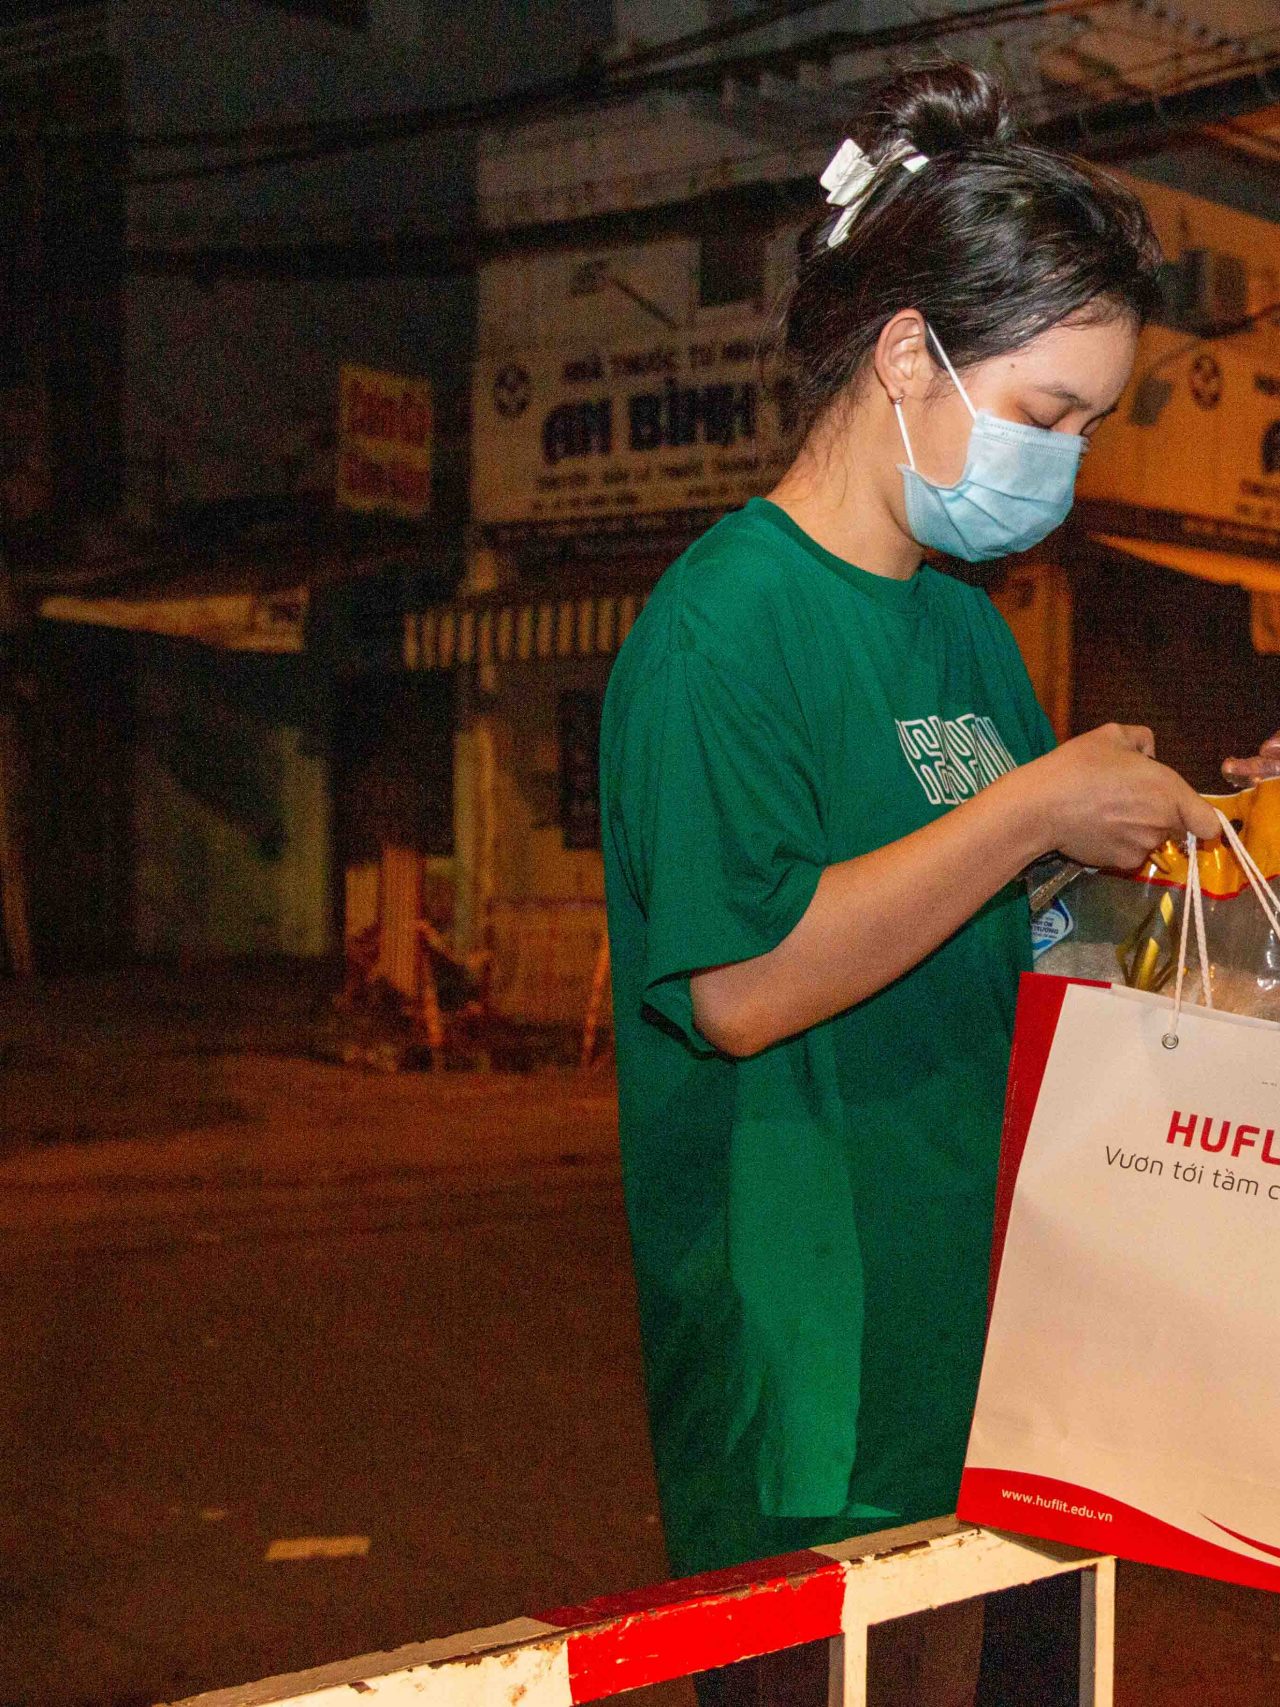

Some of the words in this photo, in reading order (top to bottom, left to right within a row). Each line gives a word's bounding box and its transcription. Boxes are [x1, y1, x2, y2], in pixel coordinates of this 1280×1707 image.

[542, 398, 613, 466] AN
[628, 376, 758, 453] BÌNH
[1105, 1145, 1164, 1176] Vươn
[1173, 1160, 1205, 1185] tới
[1212, 1167, 1260, 1196] tầm
[1001, 1488, 1113, 1523] www.huflit.edu.vn
